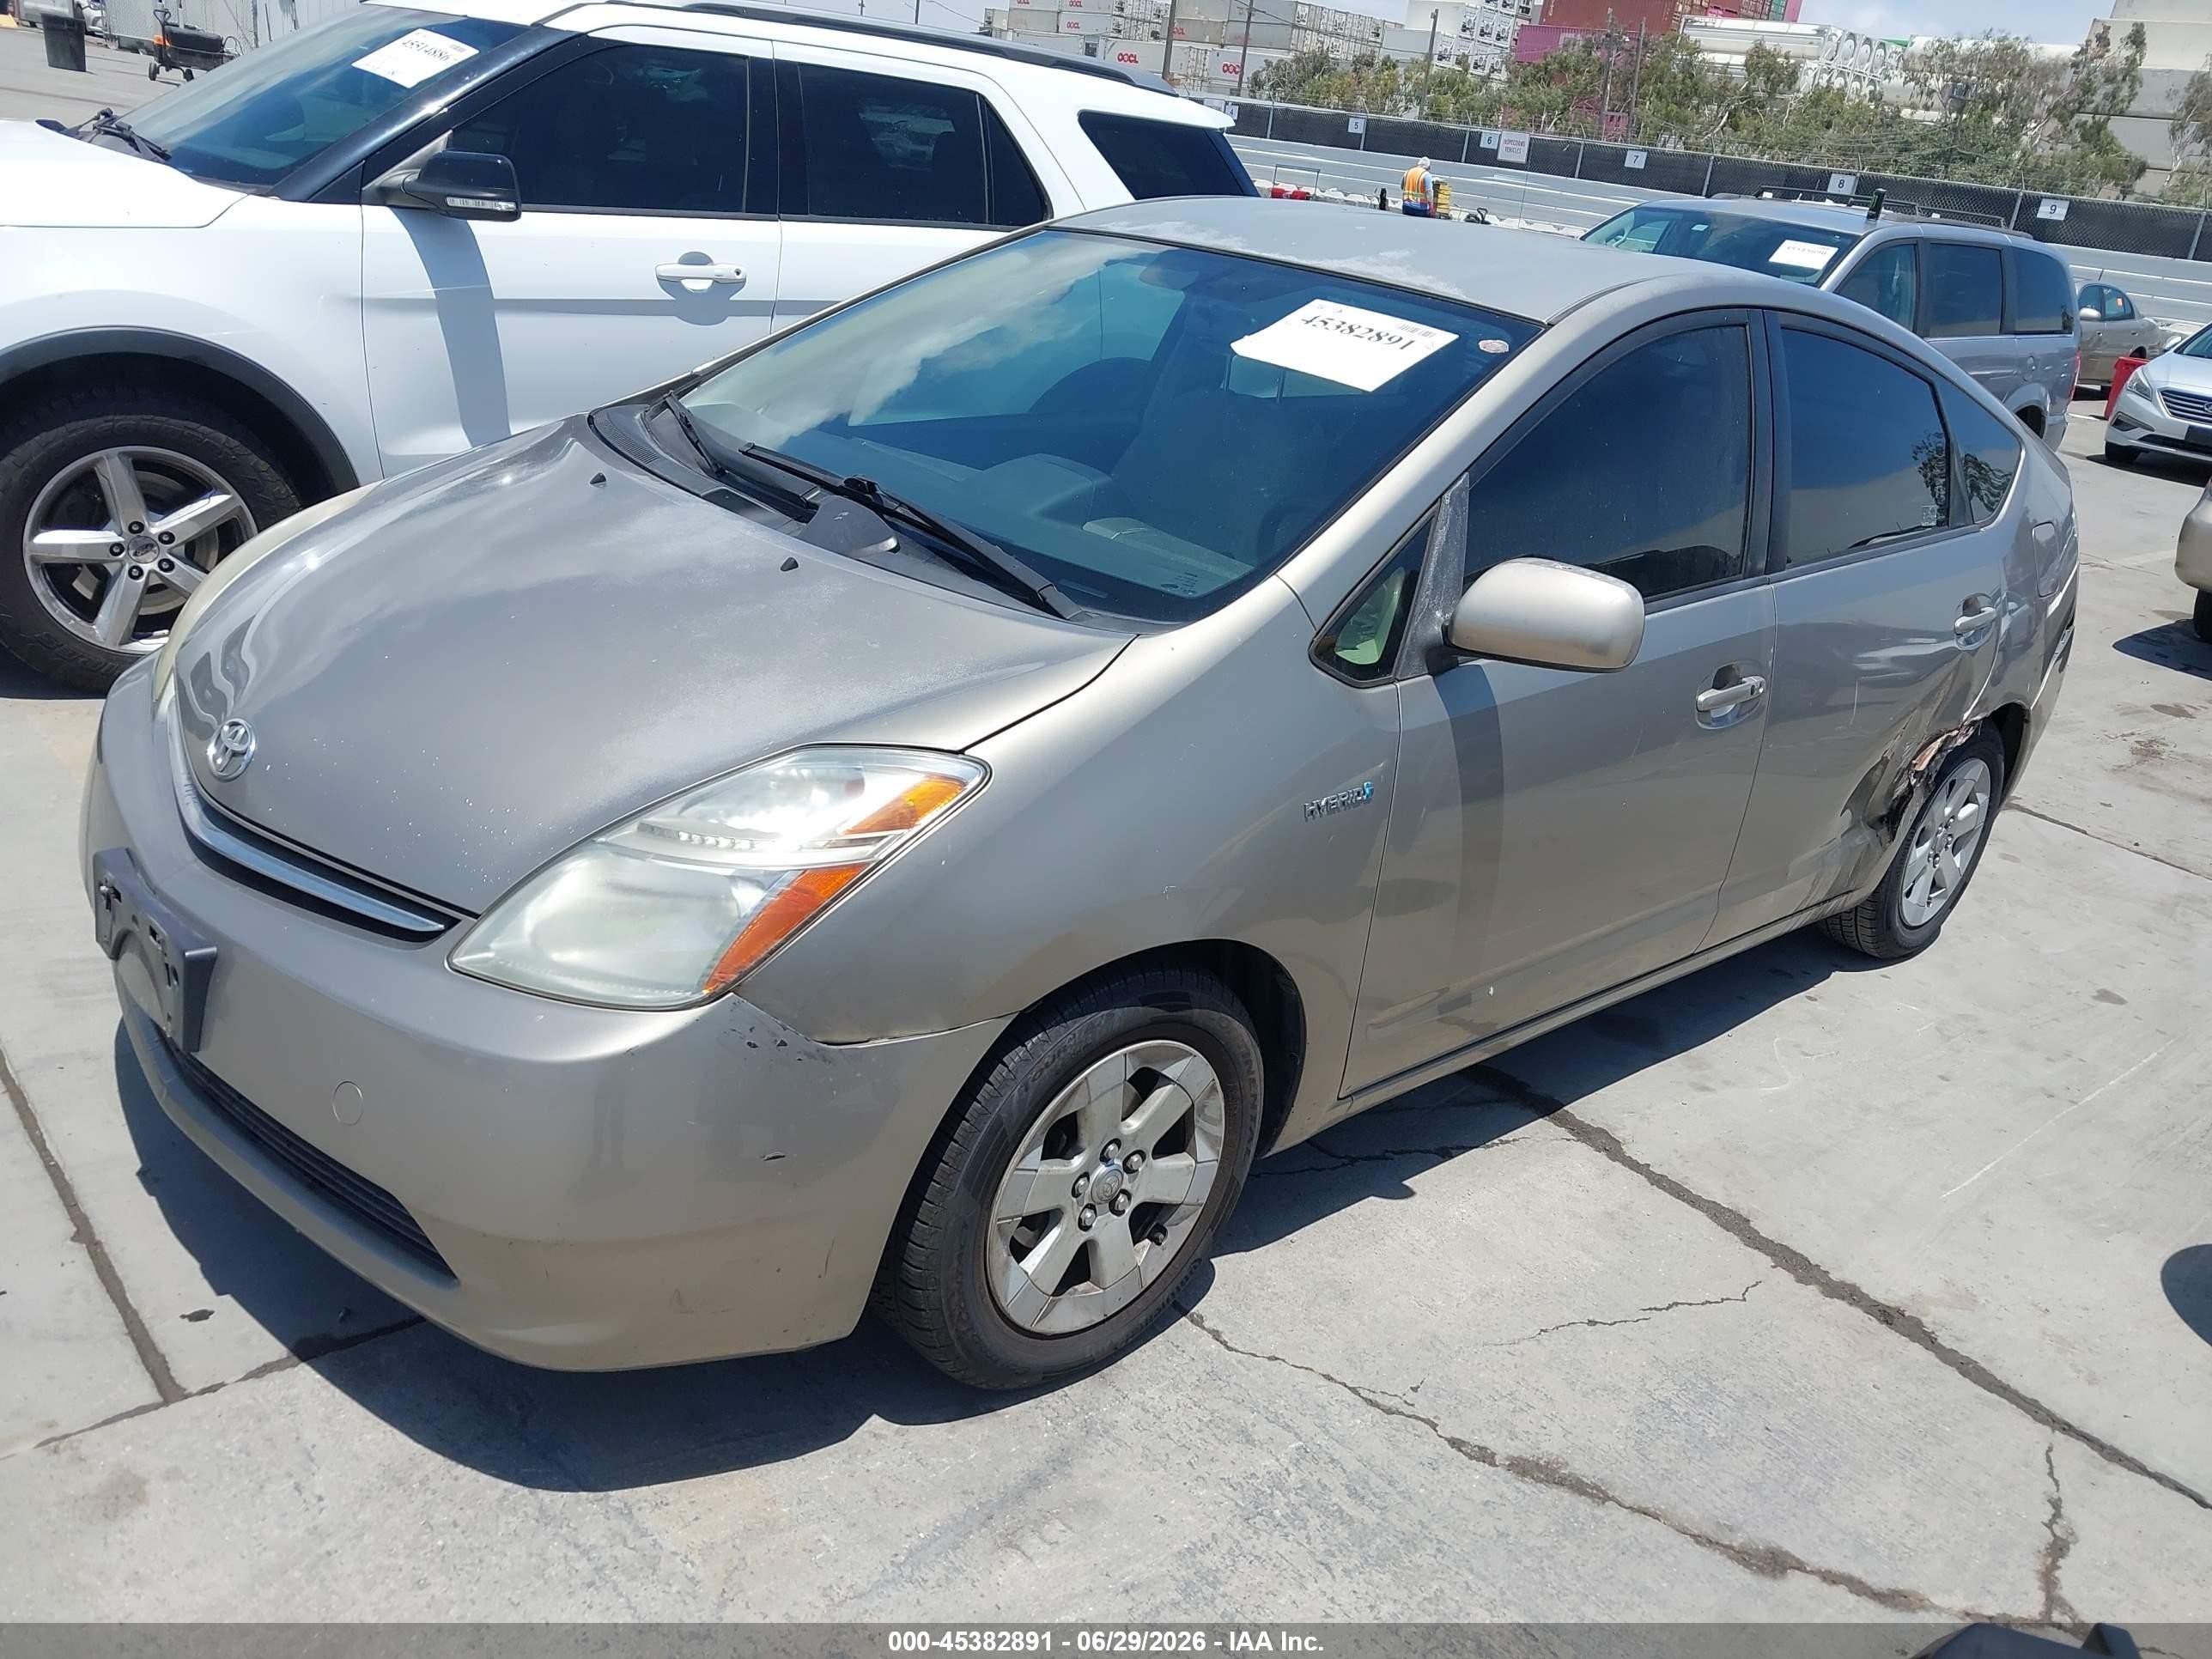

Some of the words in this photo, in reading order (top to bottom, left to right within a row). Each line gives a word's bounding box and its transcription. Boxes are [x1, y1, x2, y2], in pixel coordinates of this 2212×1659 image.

[1117, 52, 1139, 64] OOCL
[1223, 64, 1242, 75] OOC
[1632, 155, 1639, 164] 7
[1838, 179, 1844, 188] 8
[2050, 204, 2057, 214] 9
[1301, 314, 1415, 350] 45382891
[1304, 787, 1364, 818] HYBRID
